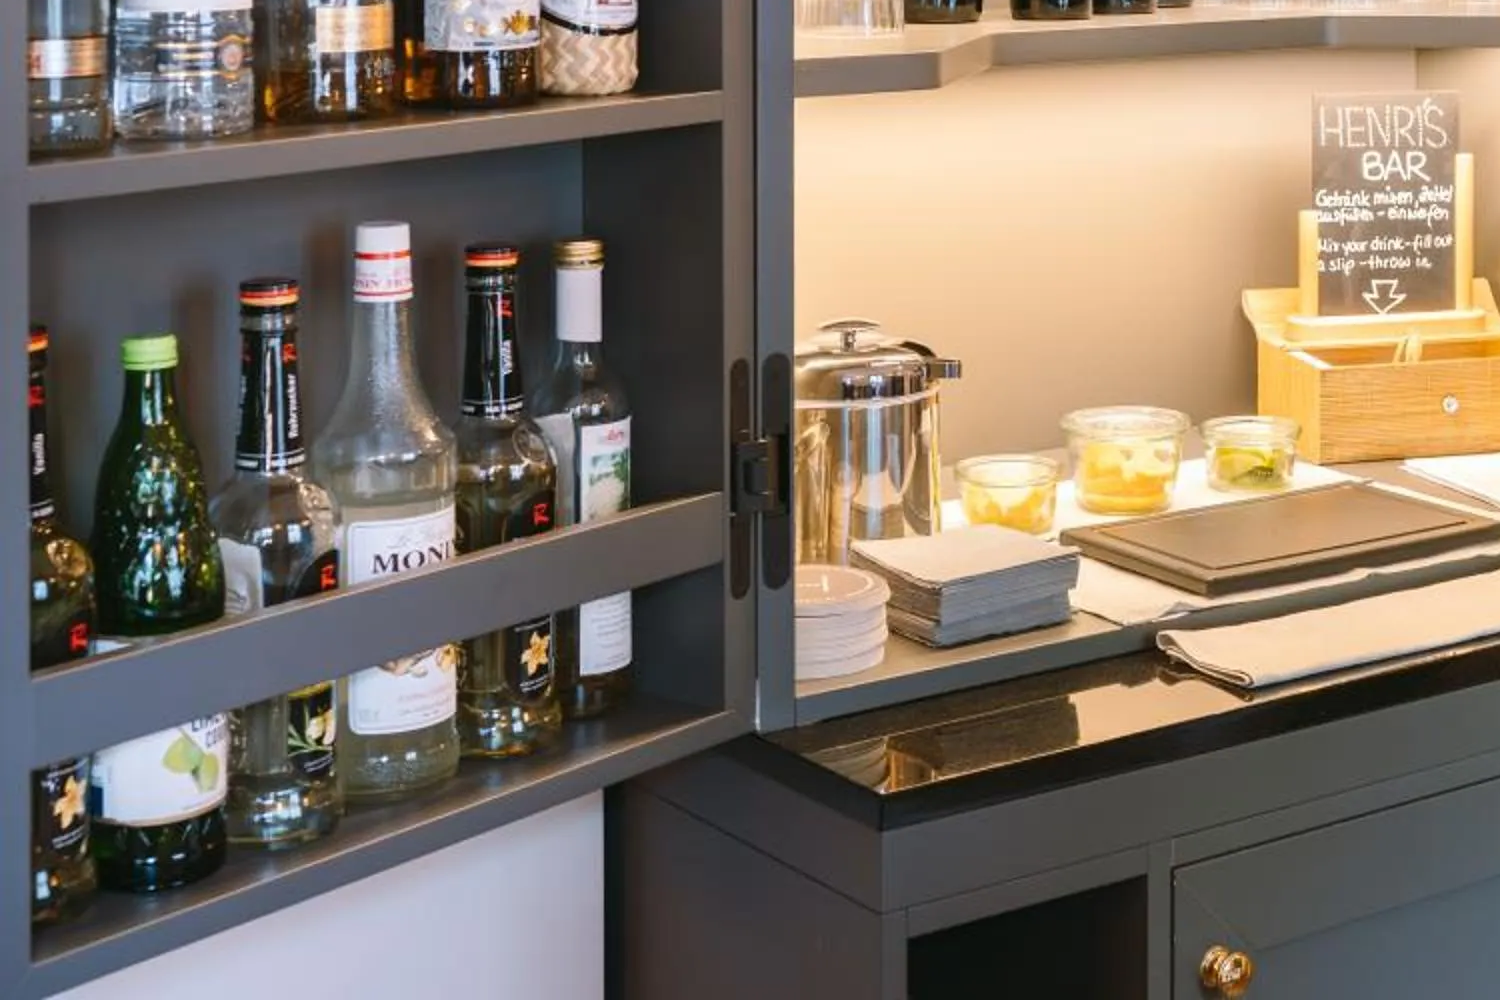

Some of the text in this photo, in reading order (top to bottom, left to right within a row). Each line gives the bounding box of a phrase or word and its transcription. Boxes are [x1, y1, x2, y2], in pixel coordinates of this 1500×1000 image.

[1362, 151, 1431, 181] BAR
[1341, 240, 1368, 256] your
[1434, 234, 1453, 248] out
[1329, 257, 1355, 276] slip
